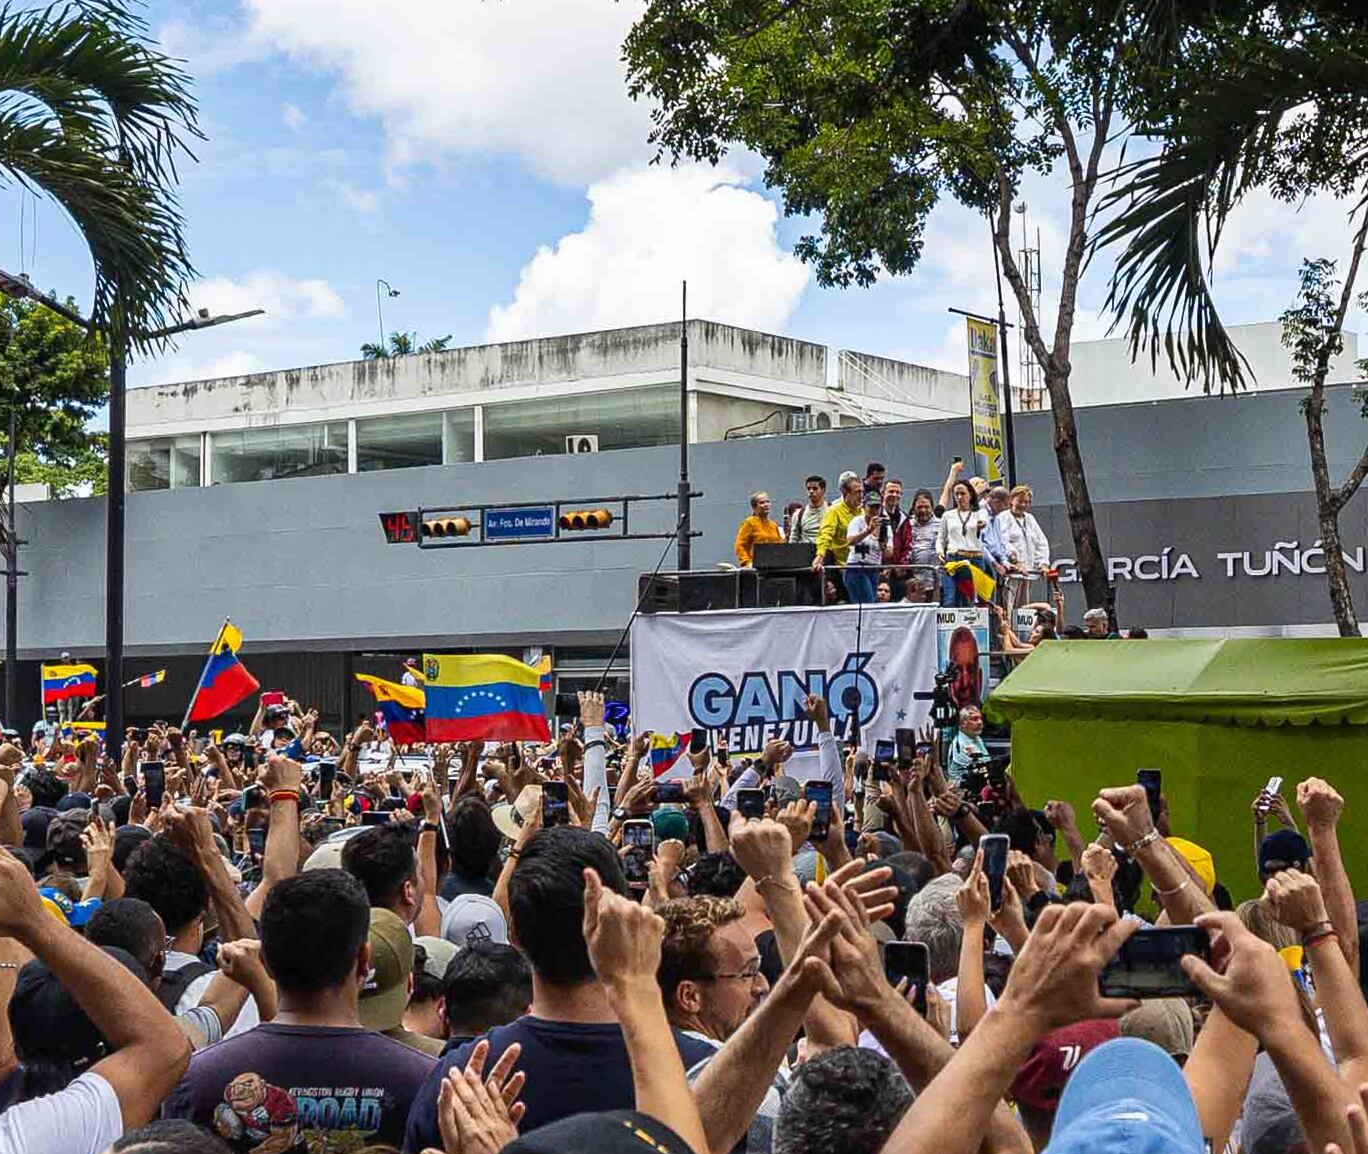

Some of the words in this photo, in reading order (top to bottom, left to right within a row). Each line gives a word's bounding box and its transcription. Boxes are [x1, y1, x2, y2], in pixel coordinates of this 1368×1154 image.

[1051, 546, 1200, 582] GRCÍA
[937, 613, 955, 624] MUD
[1017, 614, 1033, 626] MUD
[688, 651, 879, 728] GANÓ
